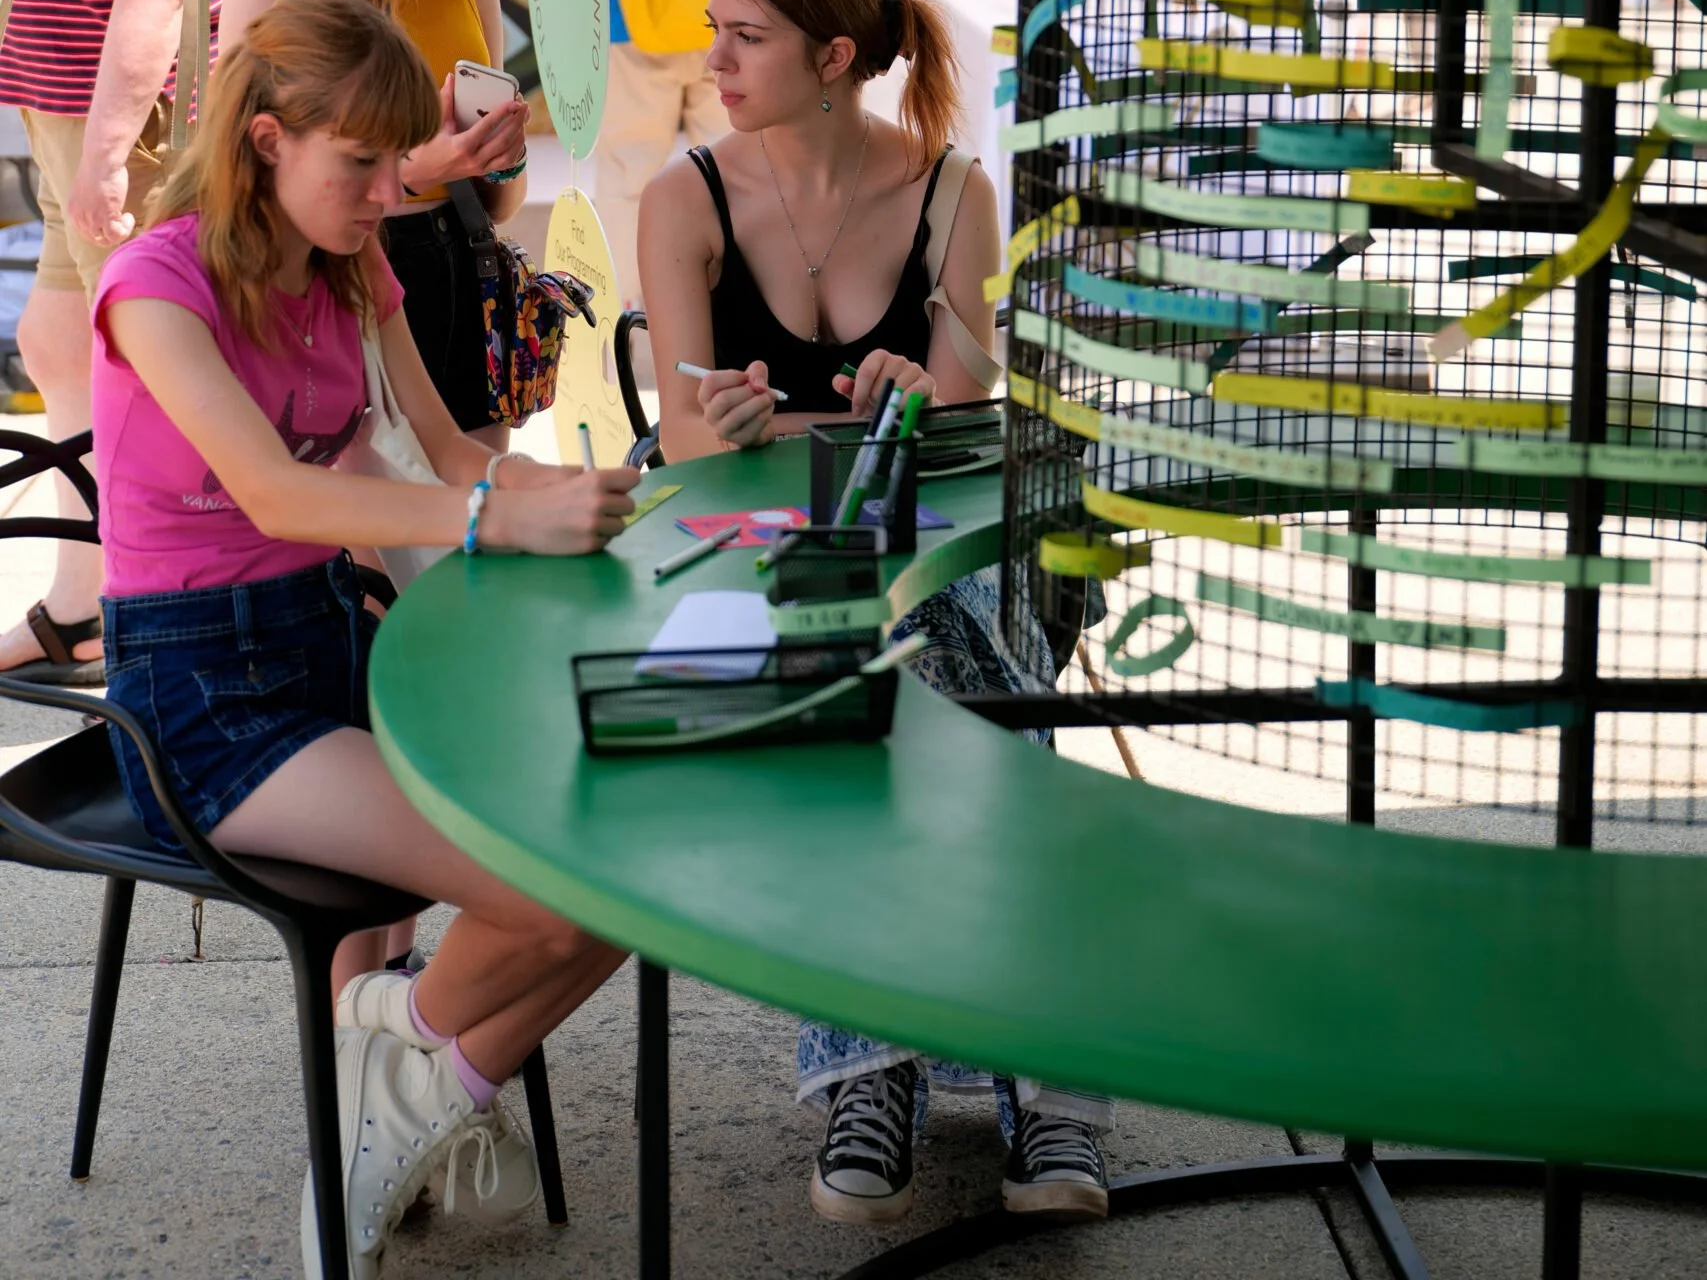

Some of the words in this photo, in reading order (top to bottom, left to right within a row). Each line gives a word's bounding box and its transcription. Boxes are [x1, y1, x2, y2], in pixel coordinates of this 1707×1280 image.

[571, 219, 586, 246] Find
[555, 239, 566, 263] Our
[566, 246, 607, 297] Programming
